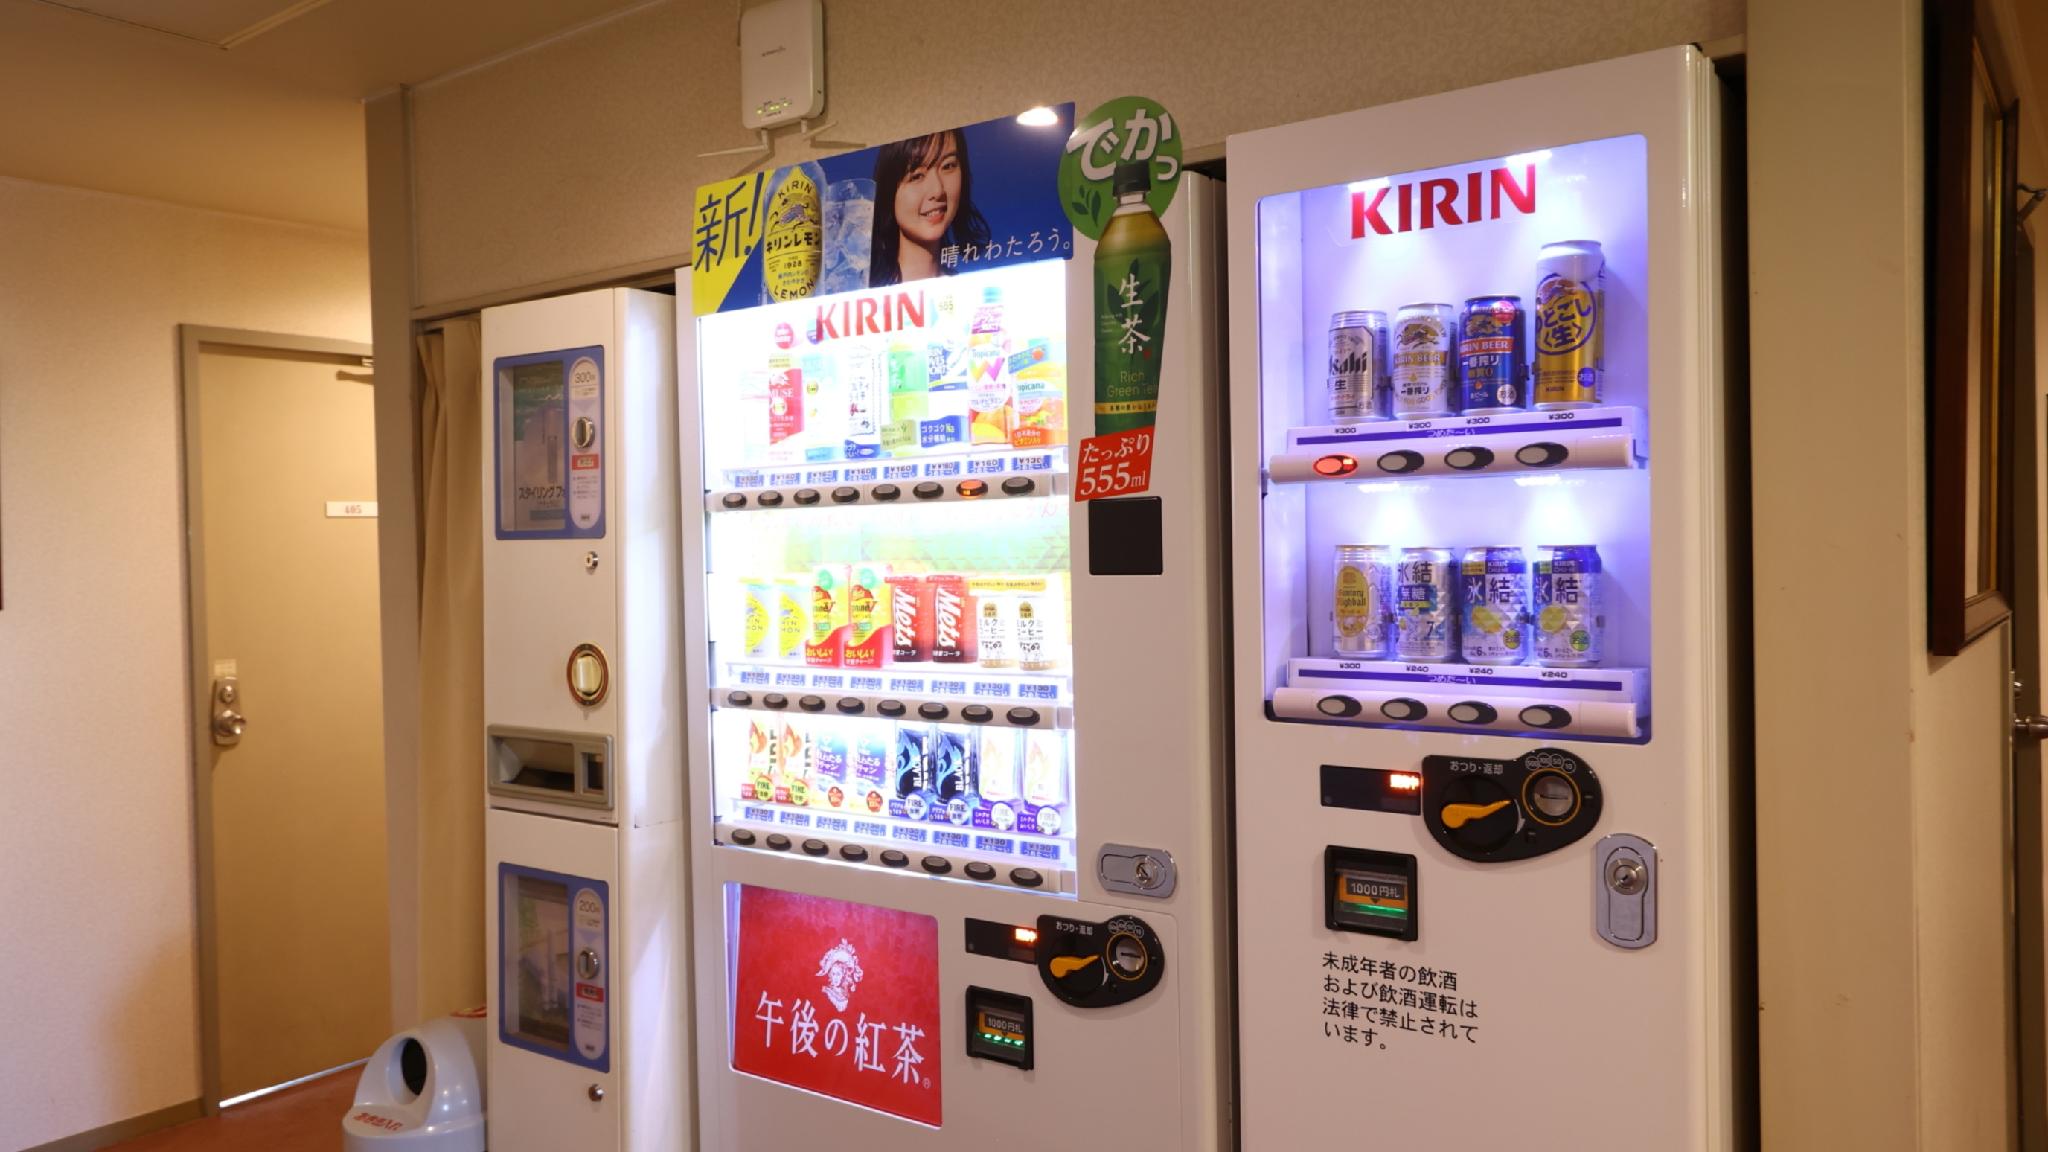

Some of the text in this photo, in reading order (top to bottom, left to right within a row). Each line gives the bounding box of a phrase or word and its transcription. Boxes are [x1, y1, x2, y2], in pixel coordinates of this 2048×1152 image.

[1066, 109, 1177, 180] でかっ
[778, 180, 813, 199] KIRIN
[1351, 163, 1536, 240] KIRIN
[694, 172, 764, 272] 新!
[766, 231, 820, 254] キリンレモン
[941, 228, 1070, 268] 晴れわたろう。
[774, 279, 815, 300] LEMON
[815, 290, 925, 342] KIRIN
[1119, 273, 1151, 354] 生茶
[1482, 340, 1509, 351] BEER
[1120, 370, 1145, 384] Rich
[1107, 384, 1140, 399] Green
[1409, 421, 1431, 430] ¥300
[1467, 417, 1490, 425] ¥300
[1082, 433, 1151, 463] たっぷり
[1080, 461, 1147, 497] 555ml
[1467, 577, 1511, 603] 氷結
[893, 585, 916, 647] Mets
[935, 585, 961, 648] Mets
[1339, 662, 1361, 670] ¥300
[1406, 665, 1430, 673] ¥240
[1469, 667, 1494, 676] ¥240
[1541, 671, 1568, 679] ¥240
[1351, 883, 1401, 898] 1000円札
[1322, 951, 1457, 991] 未成年者の飲酒
[1323, 975, 1479, 1018] および飲酒運転は
[1322, 997, 1479, 1043] 法律で禁止されて
[755, 990, 926, 1085] 午後の紅茶
[1324, 1022, 1386, 1050] います。
